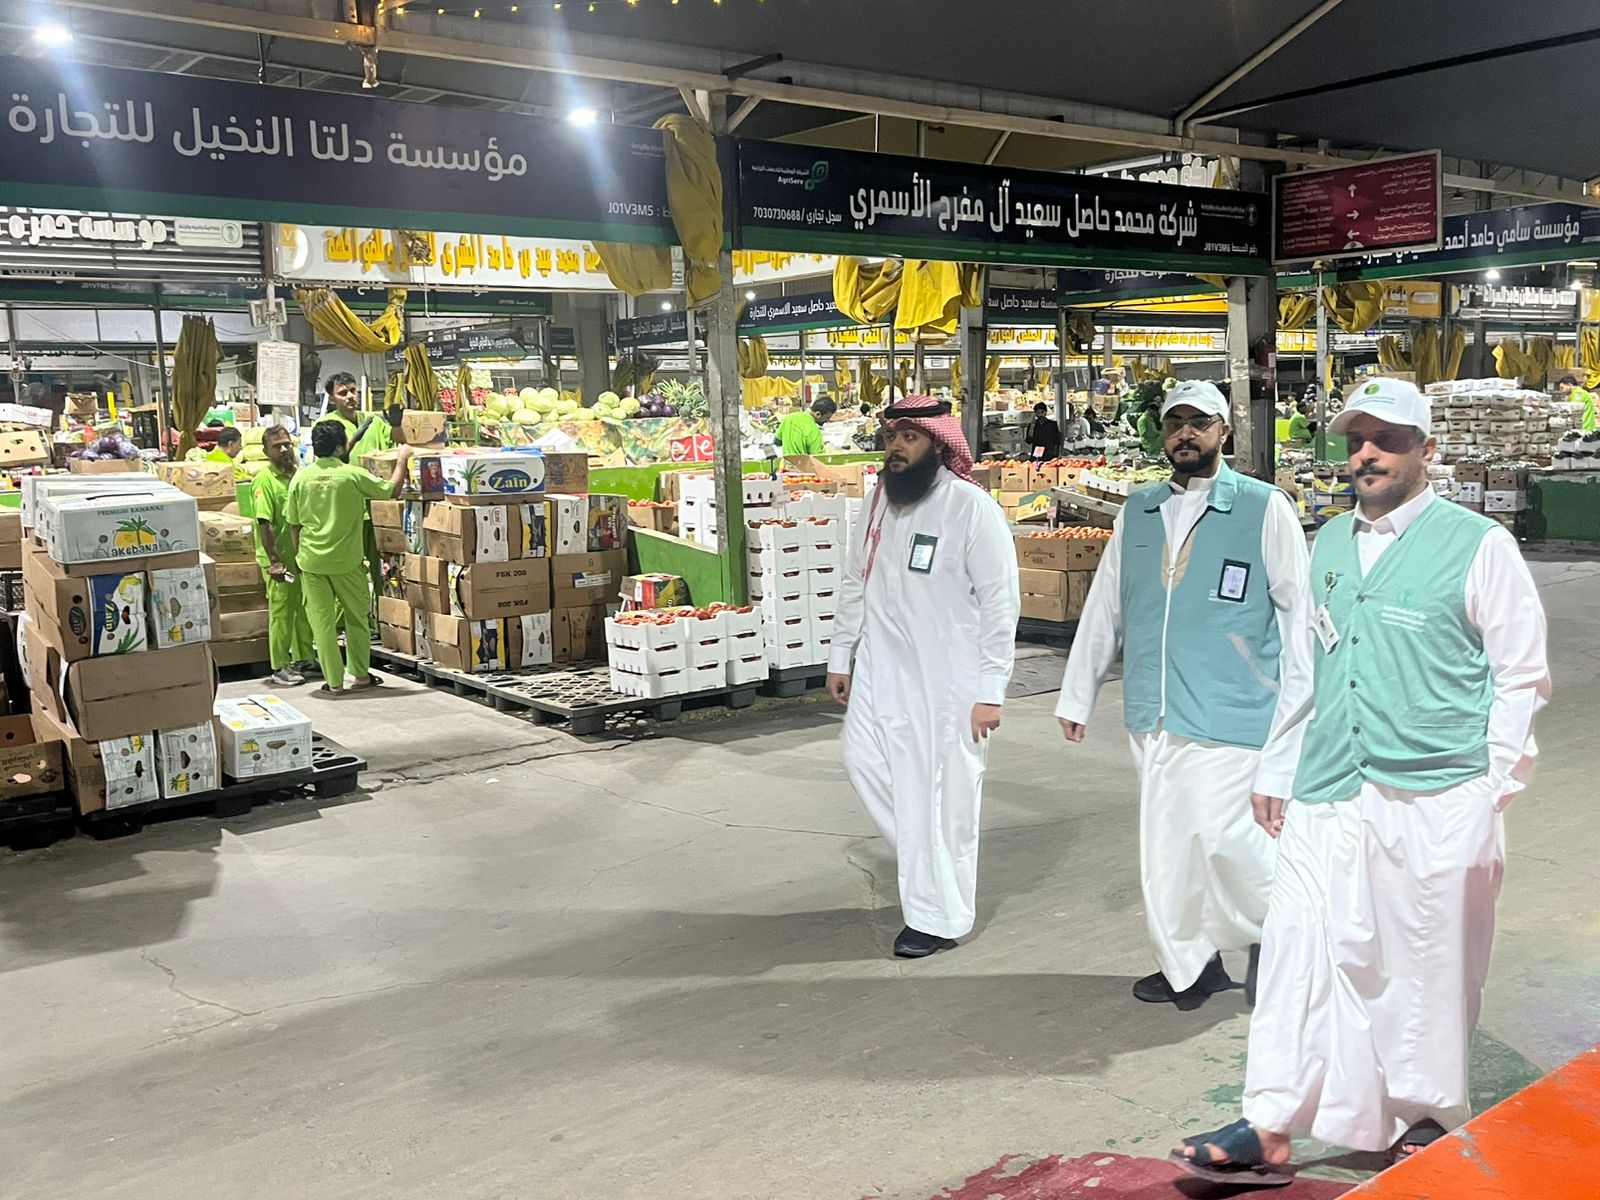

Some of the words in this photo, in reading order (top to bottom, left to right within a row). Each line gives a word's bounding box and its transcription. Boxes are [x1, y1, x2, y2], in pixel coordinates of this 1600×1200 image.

[8, 92, 155, 146] للتجارة
[172, 107, 295, 159] النخيل
[309, 119, 374, 165] دلتا
[386, 132, 529, 182] مؤسسة
[777, 176, 804, 186] AgriServ
[608, 201, 654, 217] J01V3M5
[806, 207, 825, 224] تجاري
[825, 208, 842, 225] سجل
[850, 172, 932, 230] الأسمري
[938, 186, 985, 232] مفرح
[990, 179, 1011, 231] آل
[1066, 194, 1109, 238] حاصل
[1015, 198, 1061, 239] سعيد
[1114, 204, 1155, 236] محمد
[1160, 201, 1198, 247] شركة
[1534, 214, 1580, 243] مؤسسة
[1445, 220, 1469, 250] أحمد
[1470, 223, 1494, 248] حامد
[1496, 220, 1531, 252] سامي
[749, 304, 767, 320] للتجارة
[491, 475, 529, 490] Zain
[105, 603, 116, 632] Zain
